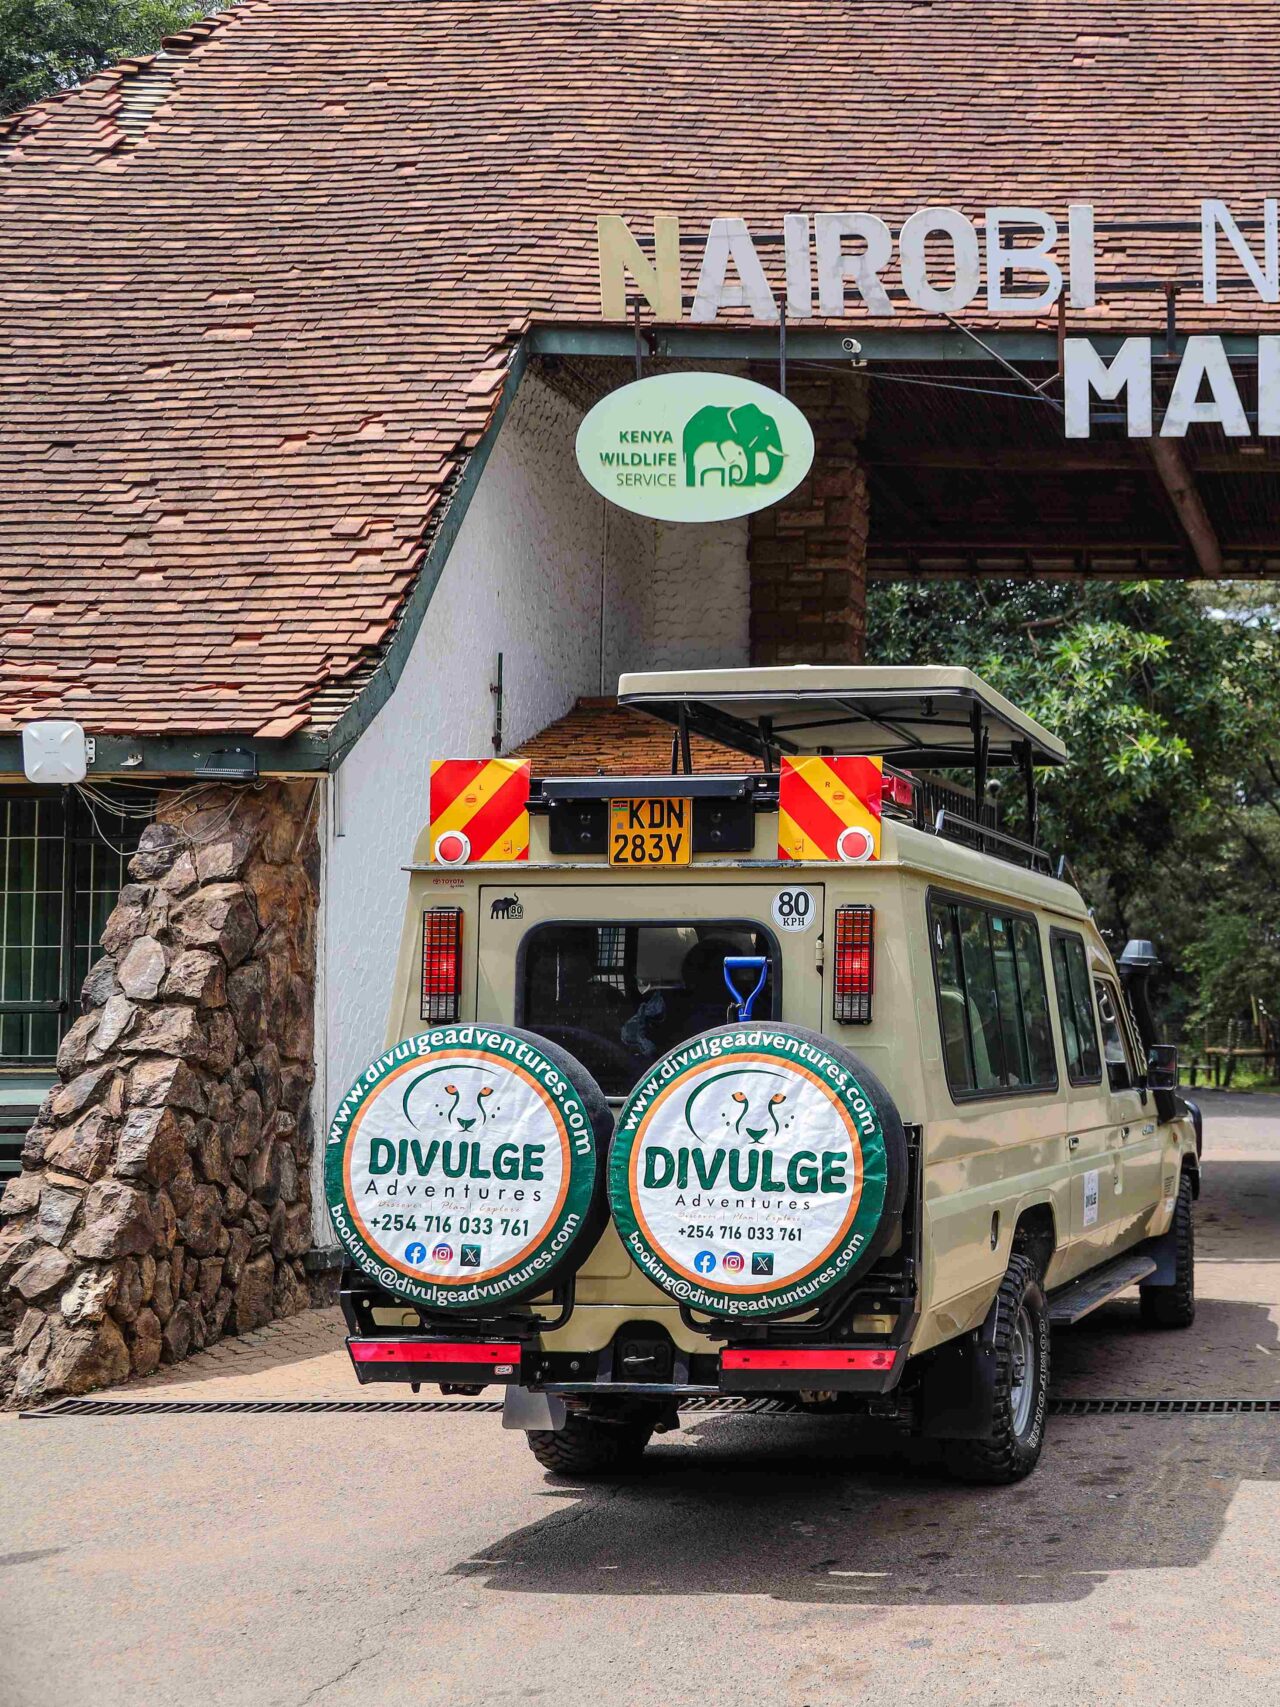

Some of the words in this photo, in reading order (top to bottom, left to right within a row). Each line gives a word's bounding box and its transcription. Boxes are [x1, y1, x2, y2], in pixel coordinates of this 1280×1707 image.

[596, 205, 1096, 322] NAIROBI
[619, 430, 673, 444] KENYA
[600, 452, 677, 467] WILDLIFE
[616, 473, 677, 487] SERVICE
[629, 799, 684, 829] KDN
[613, 833, 683, 863] 283Y
[510, 905, 522, 914] 80
[778, 891, 810, 917] 80
[782, 917, 806, 926] KPH
[328, 1027, 592, 1156] www.divulgeadventures.com
[624, 1031, 875, 1135] www.divulgeadventures.com
[368, 1137, 546, 1181] DIVULGE
[643, 1146, 848, 1194] DIVULGE
[364, 1179, 542, 1202] Adventures
[675, 1194, 811, 1210] Adventures
[370, 1214, 417, 1231] +254
[424, 1216, 451, 1233] 716
[459, 1217, 493, 1235] 033
[500, 1219, 529, 1236] 761
[678, 1225, 714, 1239] +254
[720, 1226, 742, 1240] 716
[747, 1227, 774, 1241] 033
[780, 1228, 802, 1241] 761
[331, 1203, 580, 1306] bookings@divulgeadvuntures.com
[628, 1231, 865, 1314] booking@divulgeadvuntures.com
